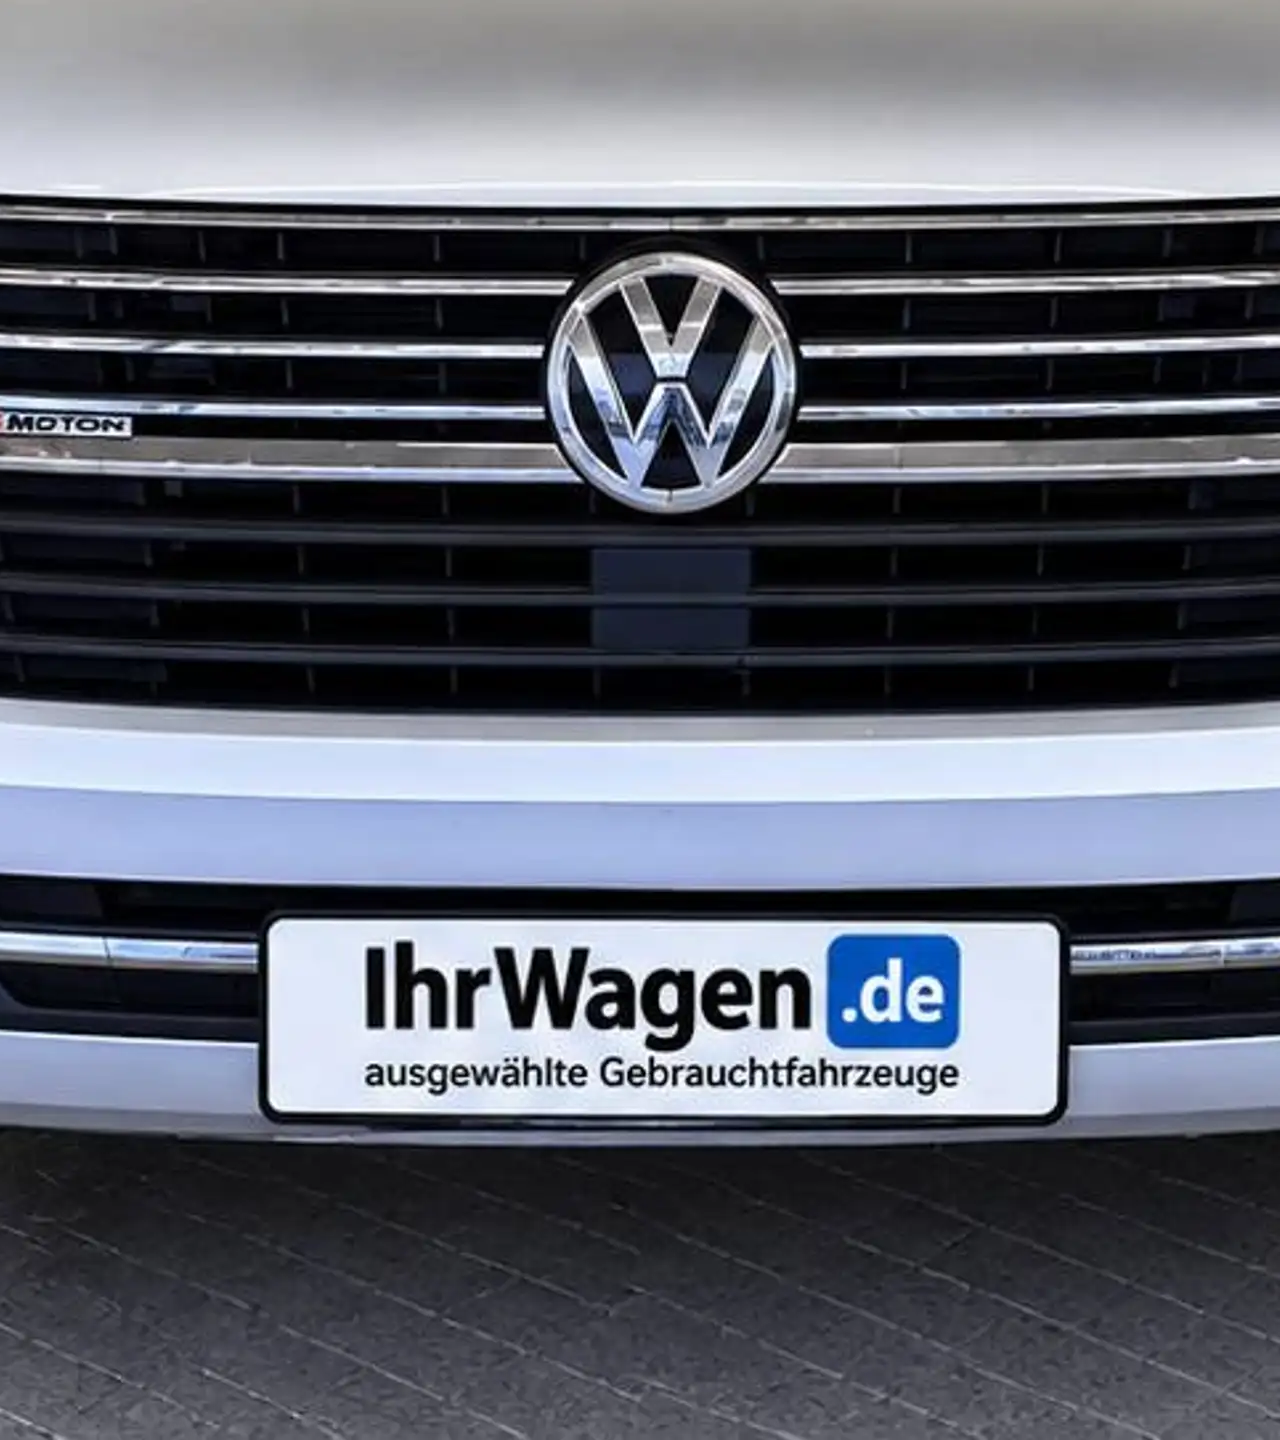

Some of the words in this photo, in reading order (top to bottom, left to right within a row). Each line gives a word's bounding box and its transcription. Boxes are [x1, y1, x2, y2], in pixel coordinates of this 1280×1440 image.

[564, 270, 776, 492] VW
[365, 1056, 588, 1093] ausgewählte
[599, 1056, 960, 1093] Gebrauchtfahrzeuge
